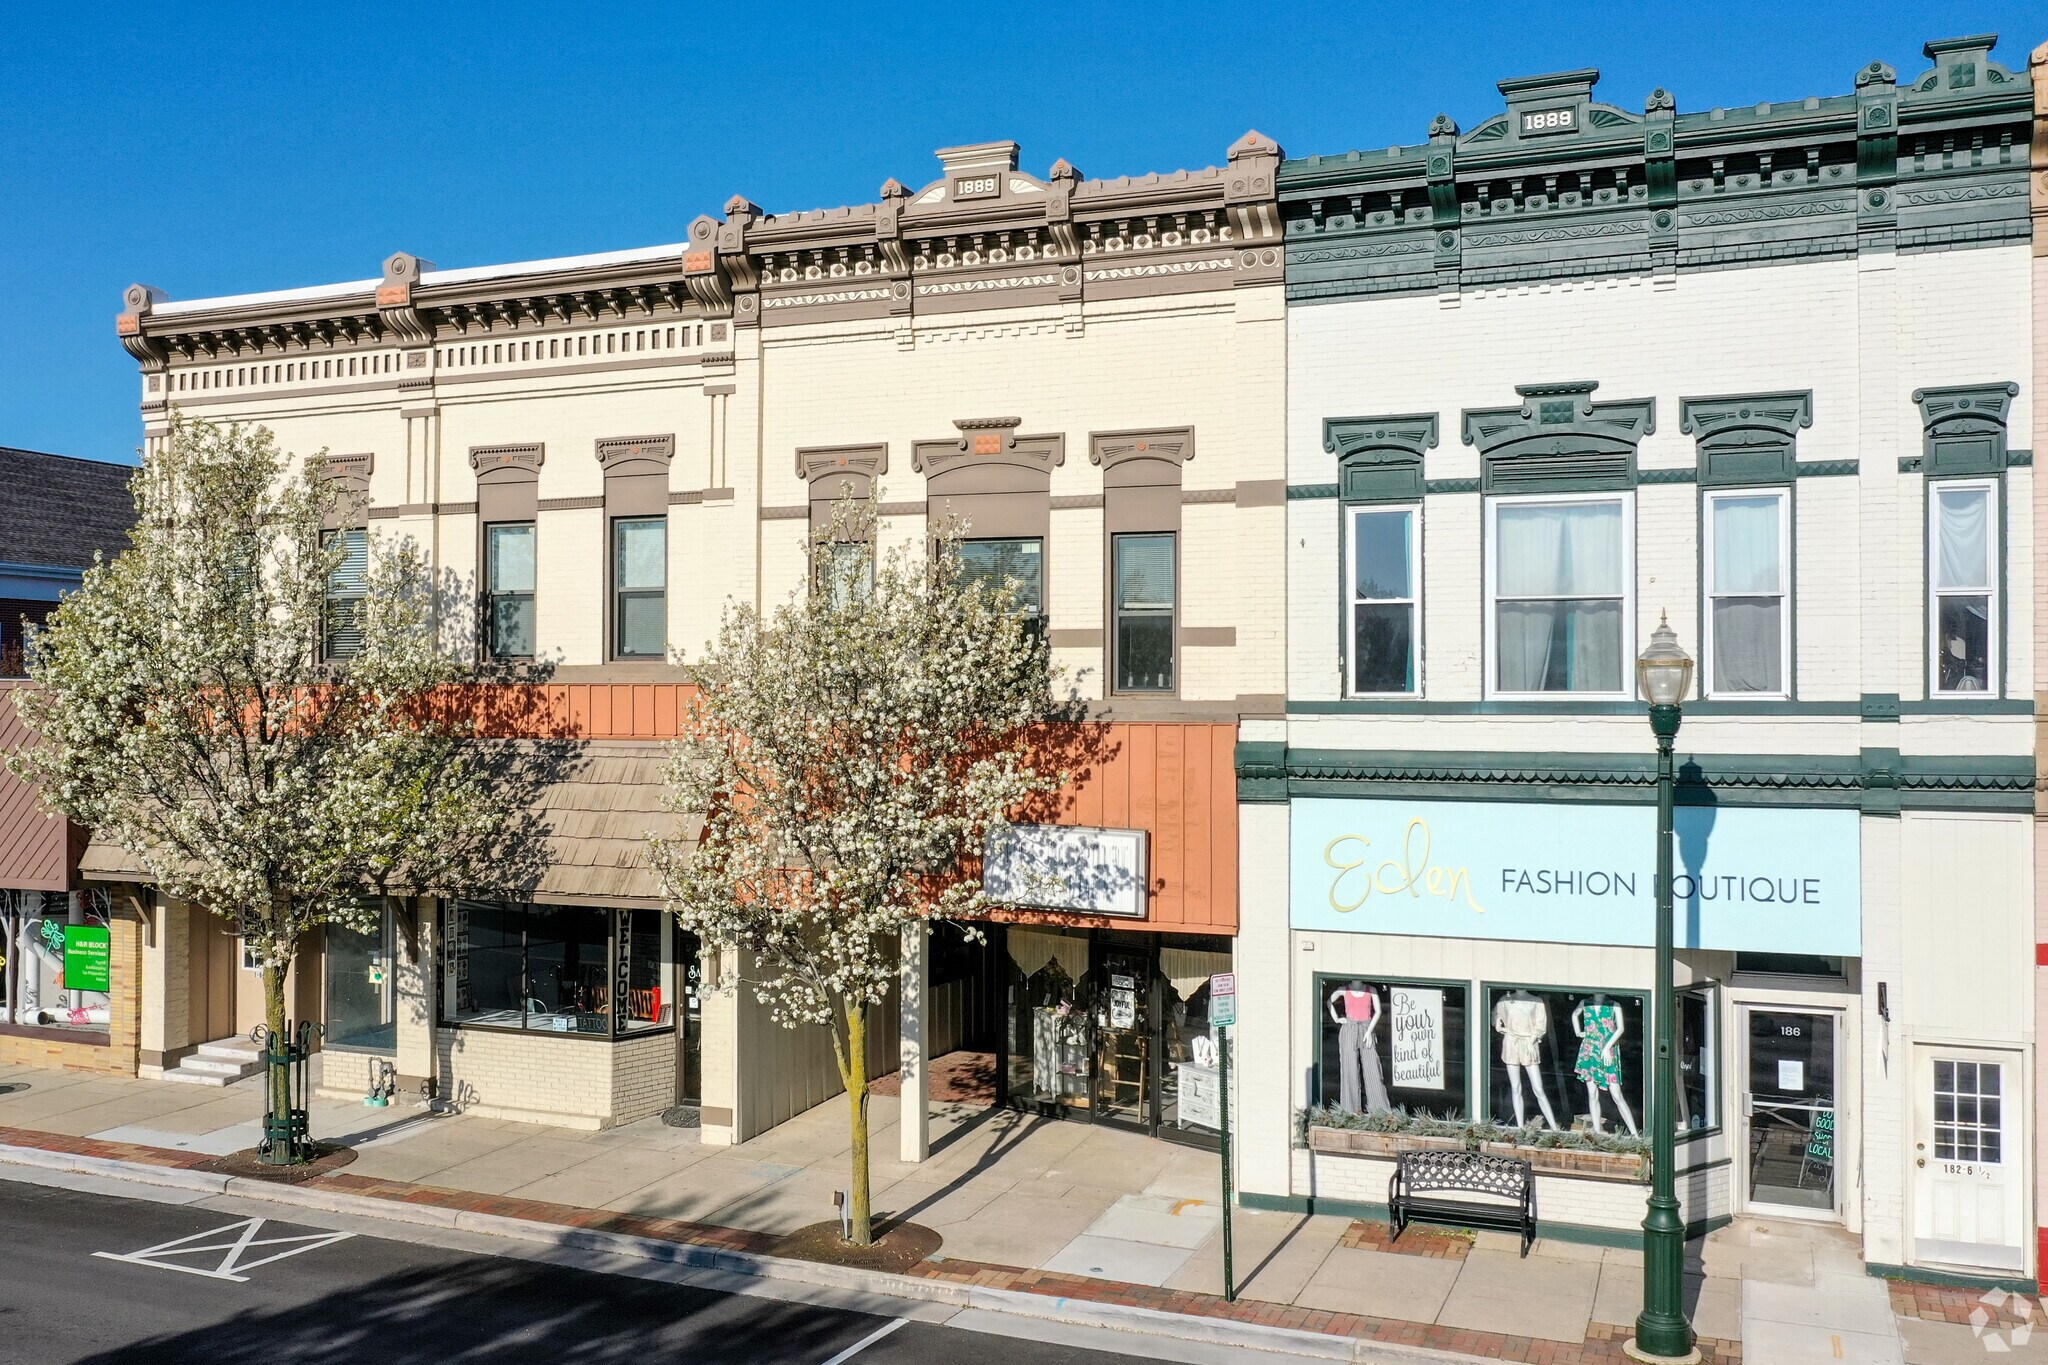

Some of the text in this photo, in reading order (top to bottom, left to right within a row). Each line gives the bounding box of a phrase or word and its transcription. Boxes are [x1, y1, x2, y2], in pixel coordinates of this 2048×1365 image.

[1525, 111, 1571, 130] 1889
[1324, 816, 1821, 913] Eden FASHION OUTIQUE
[617, 911, 632, 1031] WELCOME
[1113, 1000, 1131, 1009] JOYFUL
[1392, 992, 1416, 1016] Be
[578, 1017, 608, 1030] TATTOO
[1395, 1009, 1434, 1042] your
[1780, 1026, 1801, 1037] 186
[1410, 1028, 1436, 1043] own
[1393, 1039, 1434, 1063] kind of
[1393, 1060, 1441, 1082] beautiful
[1808, 1142, 1834, 1159] LOCAL
[1944, 1164, 1973, 1175] 182-6
